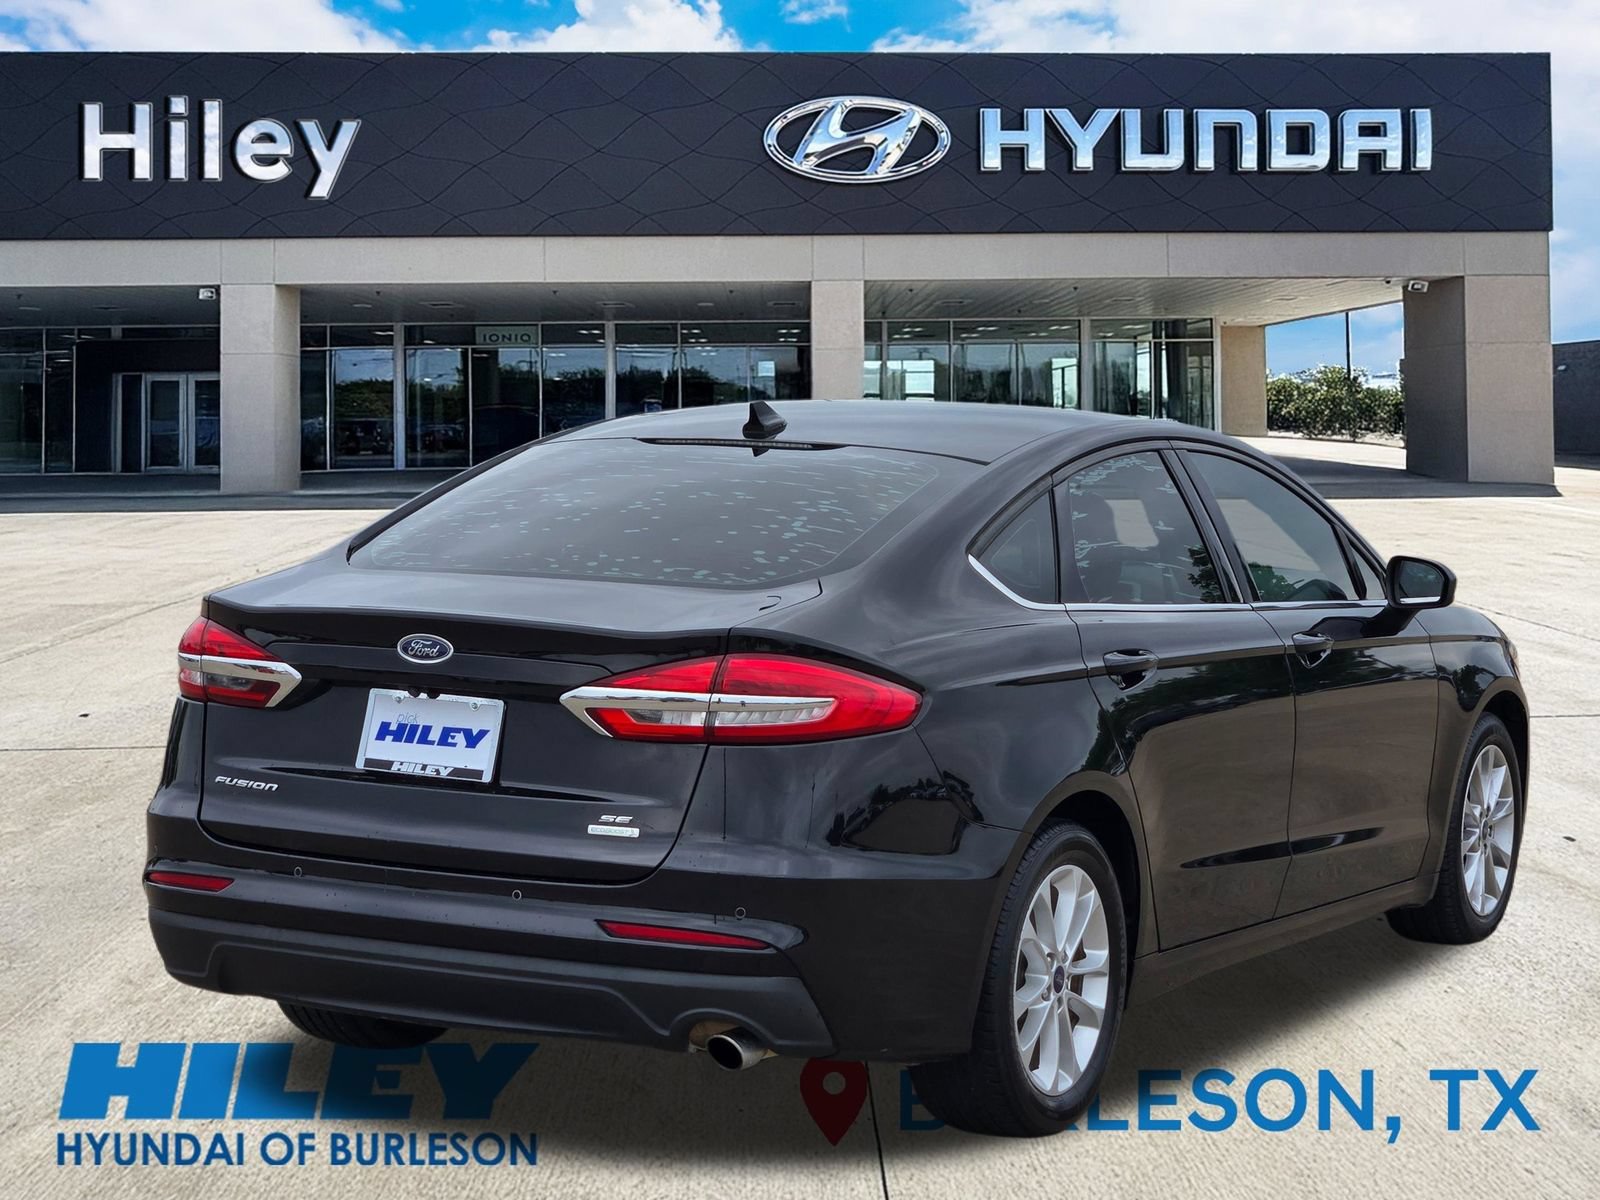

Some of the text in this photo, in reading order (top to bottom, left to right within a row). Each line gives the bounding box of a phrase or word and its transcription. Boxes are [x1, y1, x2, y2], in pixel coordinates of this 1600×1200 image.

[80, 95, 361, 199] Hiley
[979, 108, 1432, 172] HYUNDAI
[408, 639, 440, 656] Ford
[375, 721, 490, 749] HILEY
[391, 761, 454, 776] HILEY
[215, 776, 279, 791] FUSION
[599, 815, 633, 823] SE
